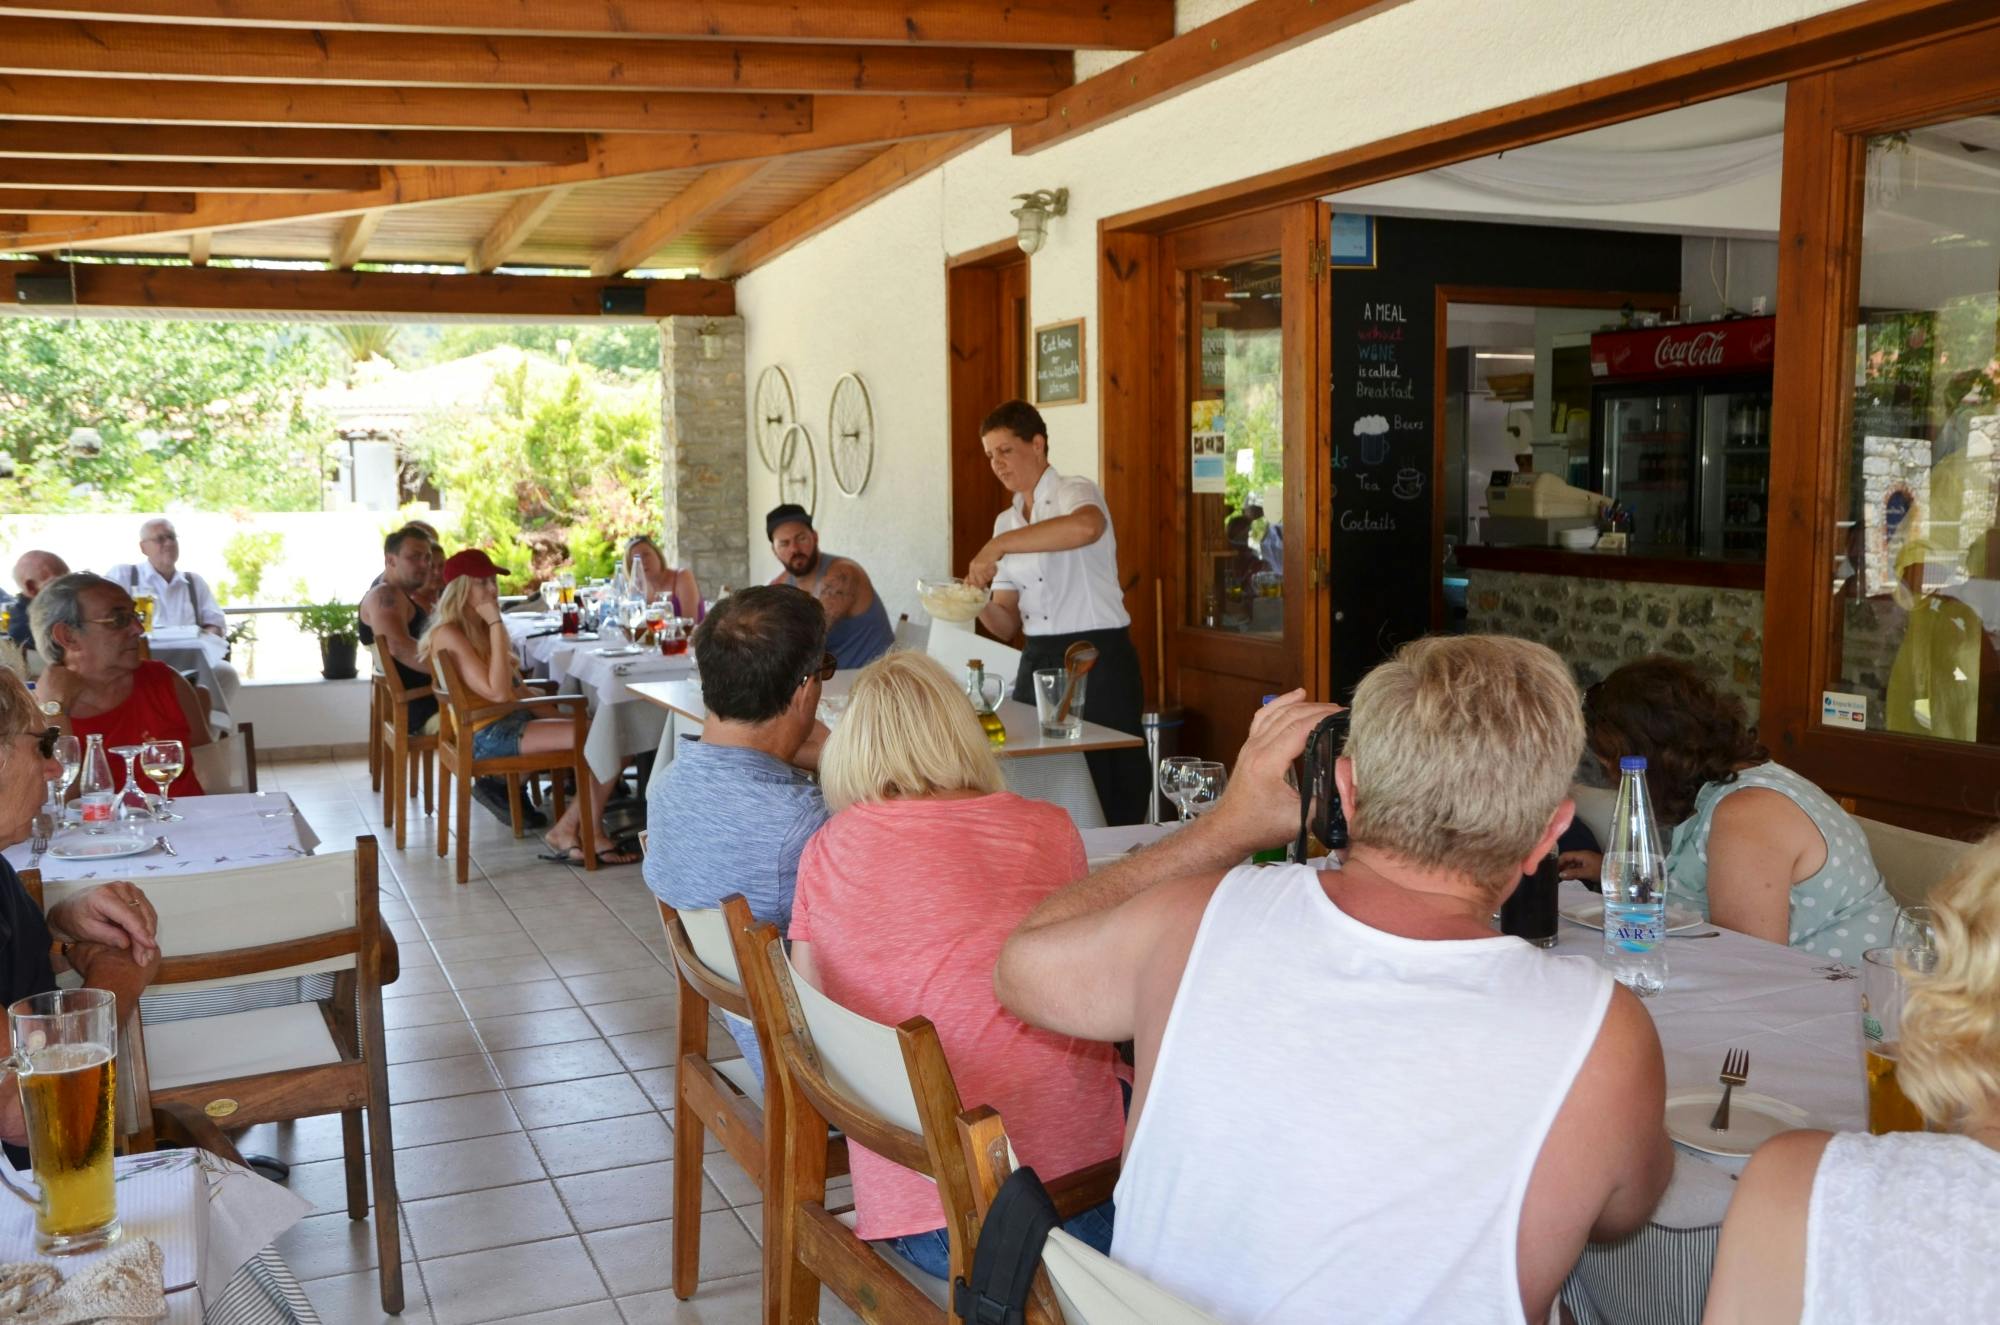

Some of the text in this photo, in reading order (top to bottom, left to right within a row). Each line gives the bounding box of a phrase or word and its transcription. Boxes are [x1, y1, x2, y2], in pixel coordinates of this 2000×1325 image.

[1364, 302, 1407, 322] A MEAL
[1654, 330, 1728, 369] Coca-Cola
[1368, 363, 1401, 378] called
[1393, 414, 1424, 430] Beers
[1355, 473, 1381, 491] Tea
[1615, 927, 1656, 940] AVRA
